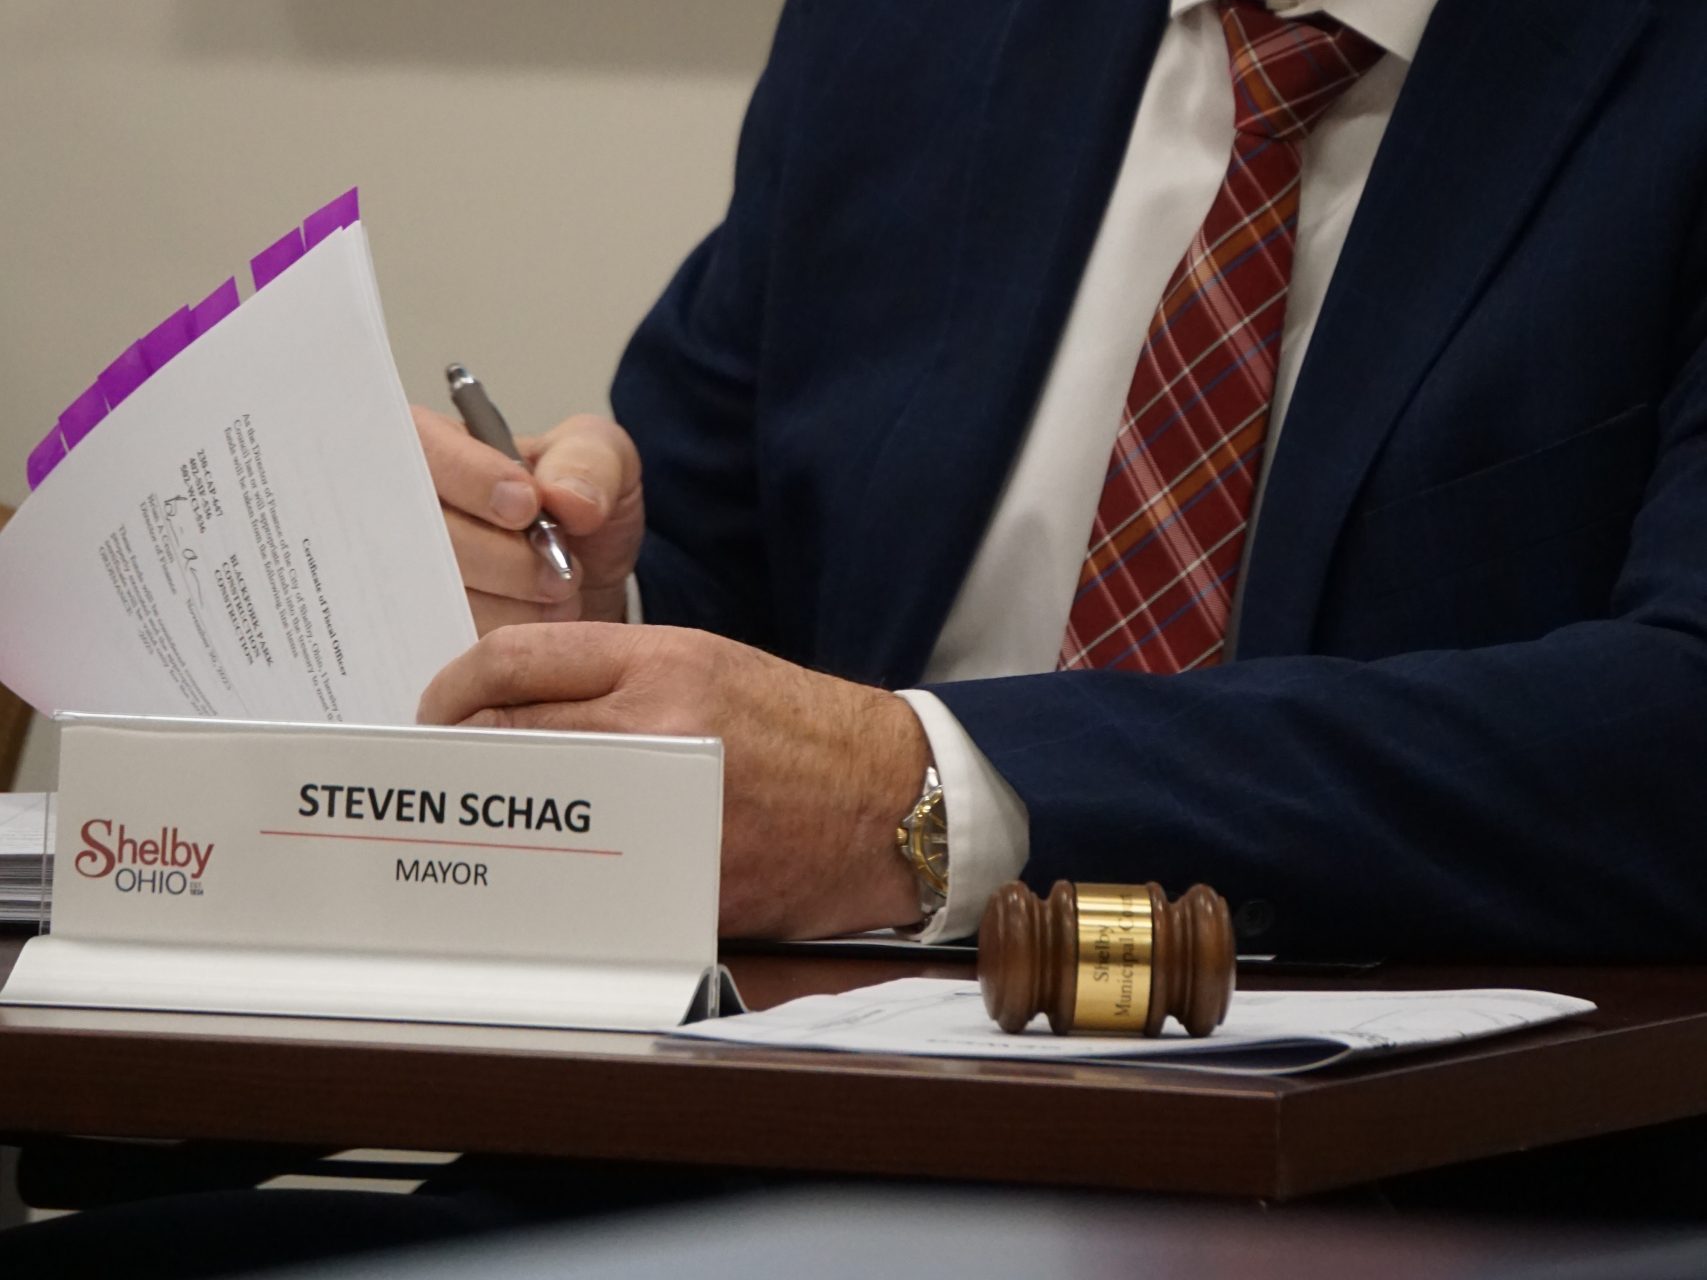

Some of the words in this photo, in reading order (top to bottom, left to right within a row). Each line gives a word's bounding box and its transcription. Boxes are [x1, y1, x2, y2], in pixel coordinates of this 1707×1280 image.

[300, 537, 324, 593] Certificate
[213, 568, 254, 665] CONSTRUCTION
[221, 561, 260, 658] CONSTRUCTION
[317, 594, 328, 606] of
[321, 606, 337, 638] Fiscal
[256, 631, 274, 667] PARK
[330, 638, 349, 677] Officer
[299, 784, 446, 825] STEVEN
[459, 793, 592, 834] SCHAG
[75, 819, 214, 879] Shelby
[395, 859, 489, 888] MAYOR
[115, 868, 187, 895] OHIO
[1094, 925, 1114, 982] Shelby
[1114, 937, 1138, 1017] Municipal
